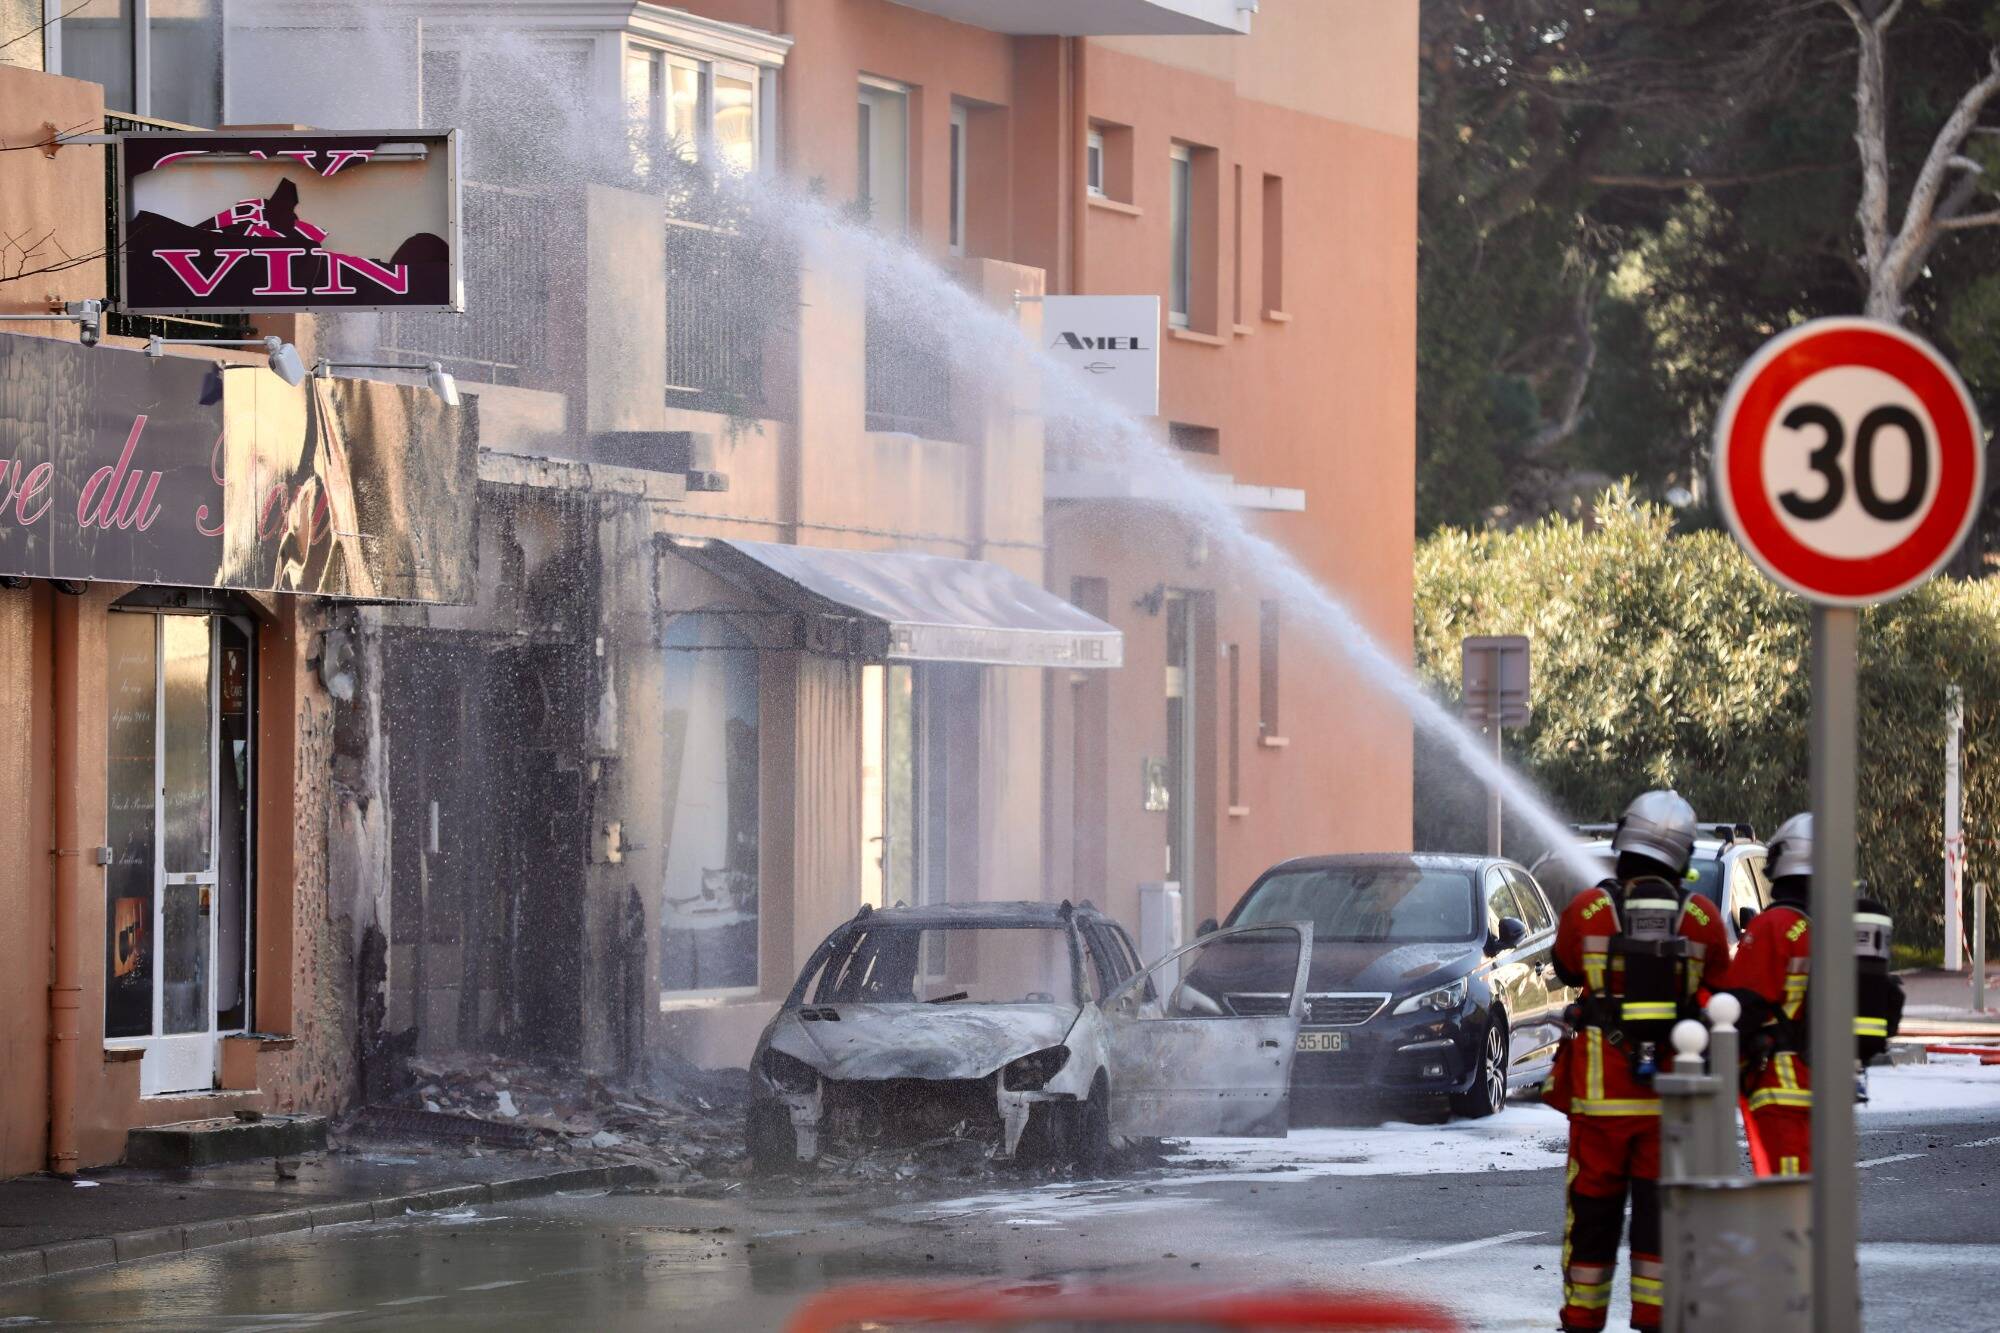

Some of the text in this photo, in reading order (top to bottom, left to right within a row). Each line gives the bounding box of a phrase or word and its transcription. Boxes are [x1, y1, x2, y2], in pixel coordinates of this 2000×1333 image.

[152, 249, 409, 297] VIN
[77, 414, 163, 532] du
[1778, 403, 1931, 522] 30
